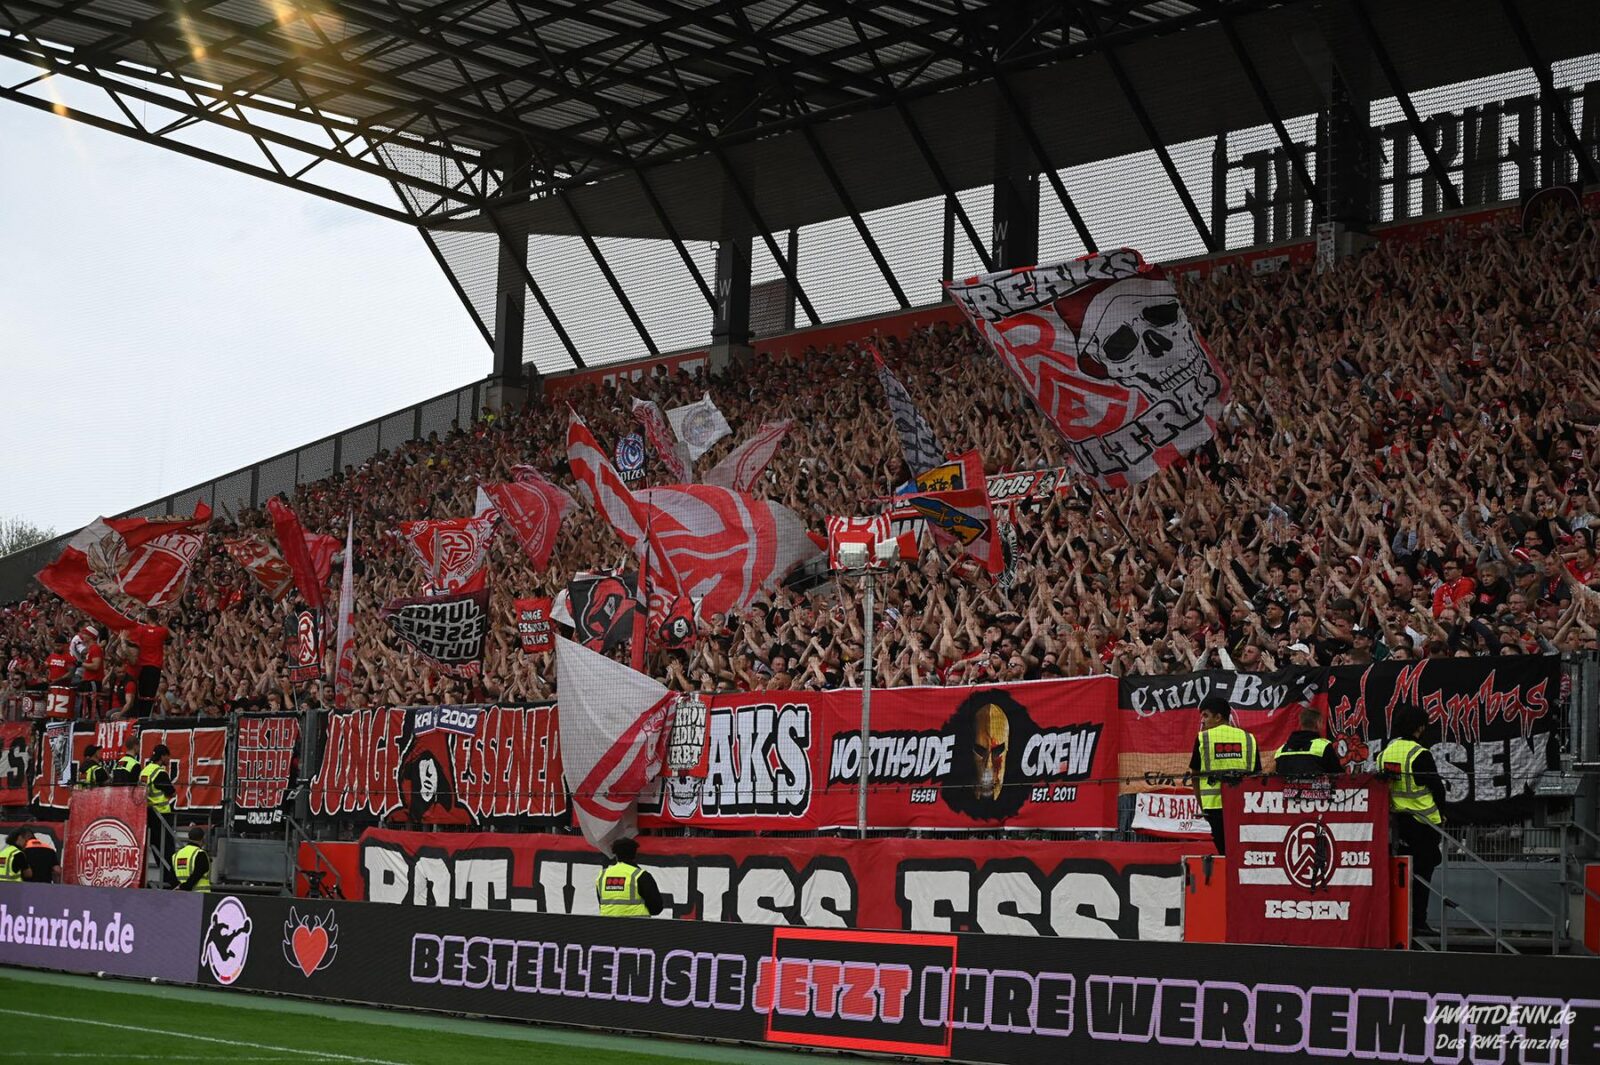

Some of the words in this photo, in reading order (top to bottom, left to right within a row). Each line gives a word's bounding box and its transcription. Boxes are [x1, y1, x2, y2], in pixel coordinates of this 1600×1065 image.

[1384, 658, 1550, 747] Mambas
[439, 707, 478, 730] 2000
[309, 705, 406, 817] JUNGE
[454, 704, 567, 817] ESSENER
[829, 733, 956, 781] NORTHSIDE
[1020, 729, 1097, 778] CREW
[910, 788, 938, 803] ESSEN
[1031, 787, 1051, 802] EST.
[1053, 786, 1077, 801] 2011
[1148, 796, 1166, 818] LA
[1243, 788, 1369, 814] KATEGORIE
[1243, 850, 1277, 866] SEIT
[1340, 850, 1370, 866] 2015
[1264, 899, 1350, 921] ESSEN
[411, 933, 656, 1003] BESTELLEN
[661, 949, 747, 1011] SIE
[752, 956, 912, 1024] JETZT
[918, 965, 1076, 1037] IHRE
